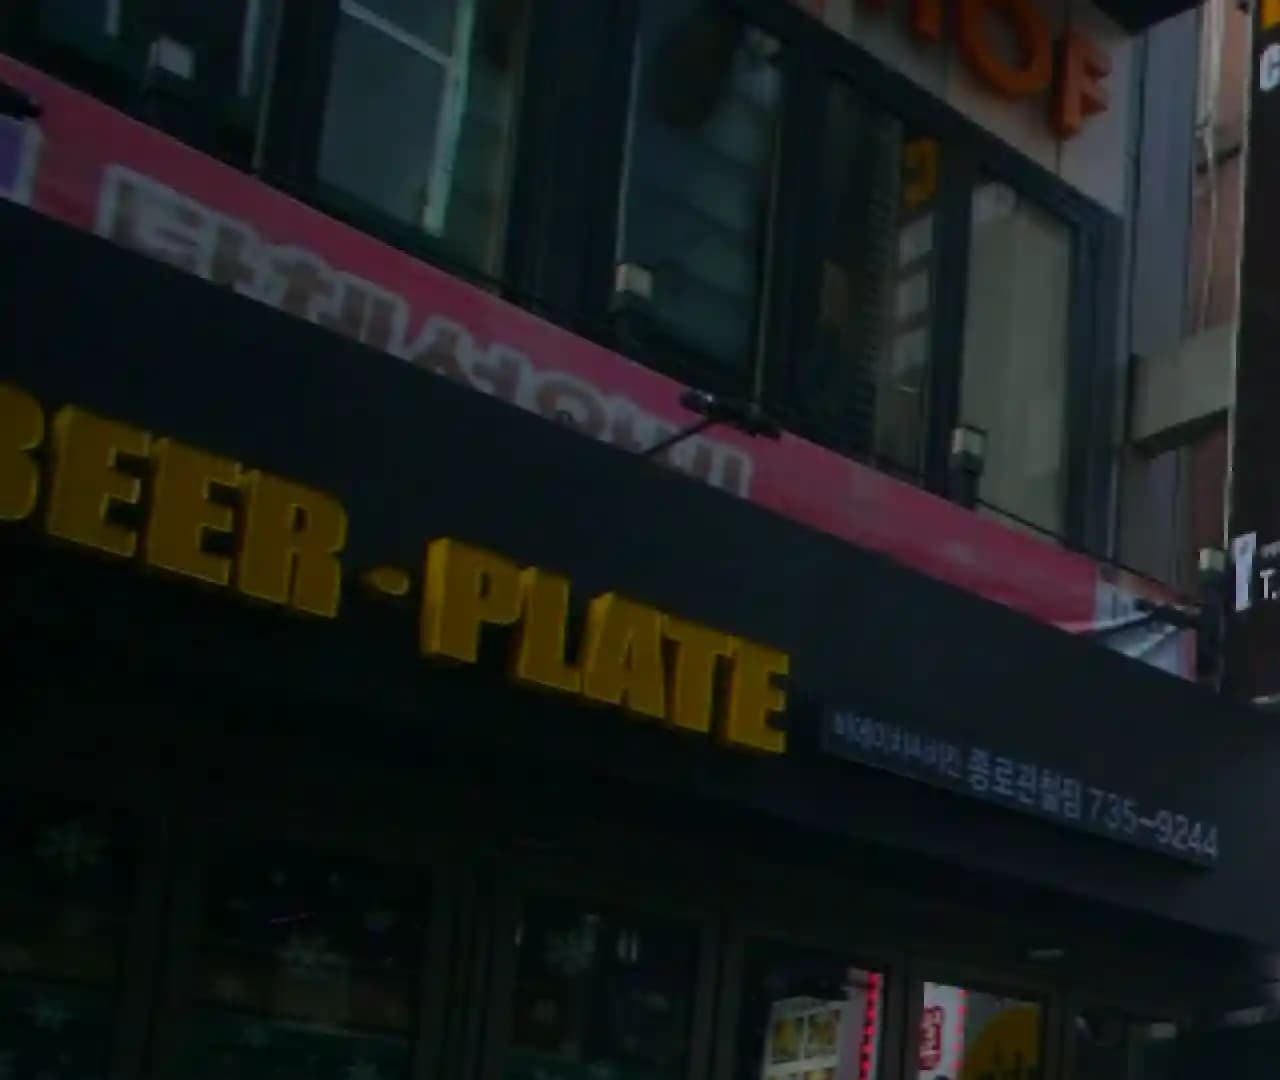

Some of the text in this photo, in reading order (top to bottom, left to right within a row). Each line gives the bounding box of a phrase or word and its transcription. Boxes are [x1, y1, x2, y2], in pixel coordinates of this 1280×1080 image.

[866, 0, 1108, 136] OF
[420, 534, 790, 755] PLATE
[1087, 786, 1220, 861] 735-9244
